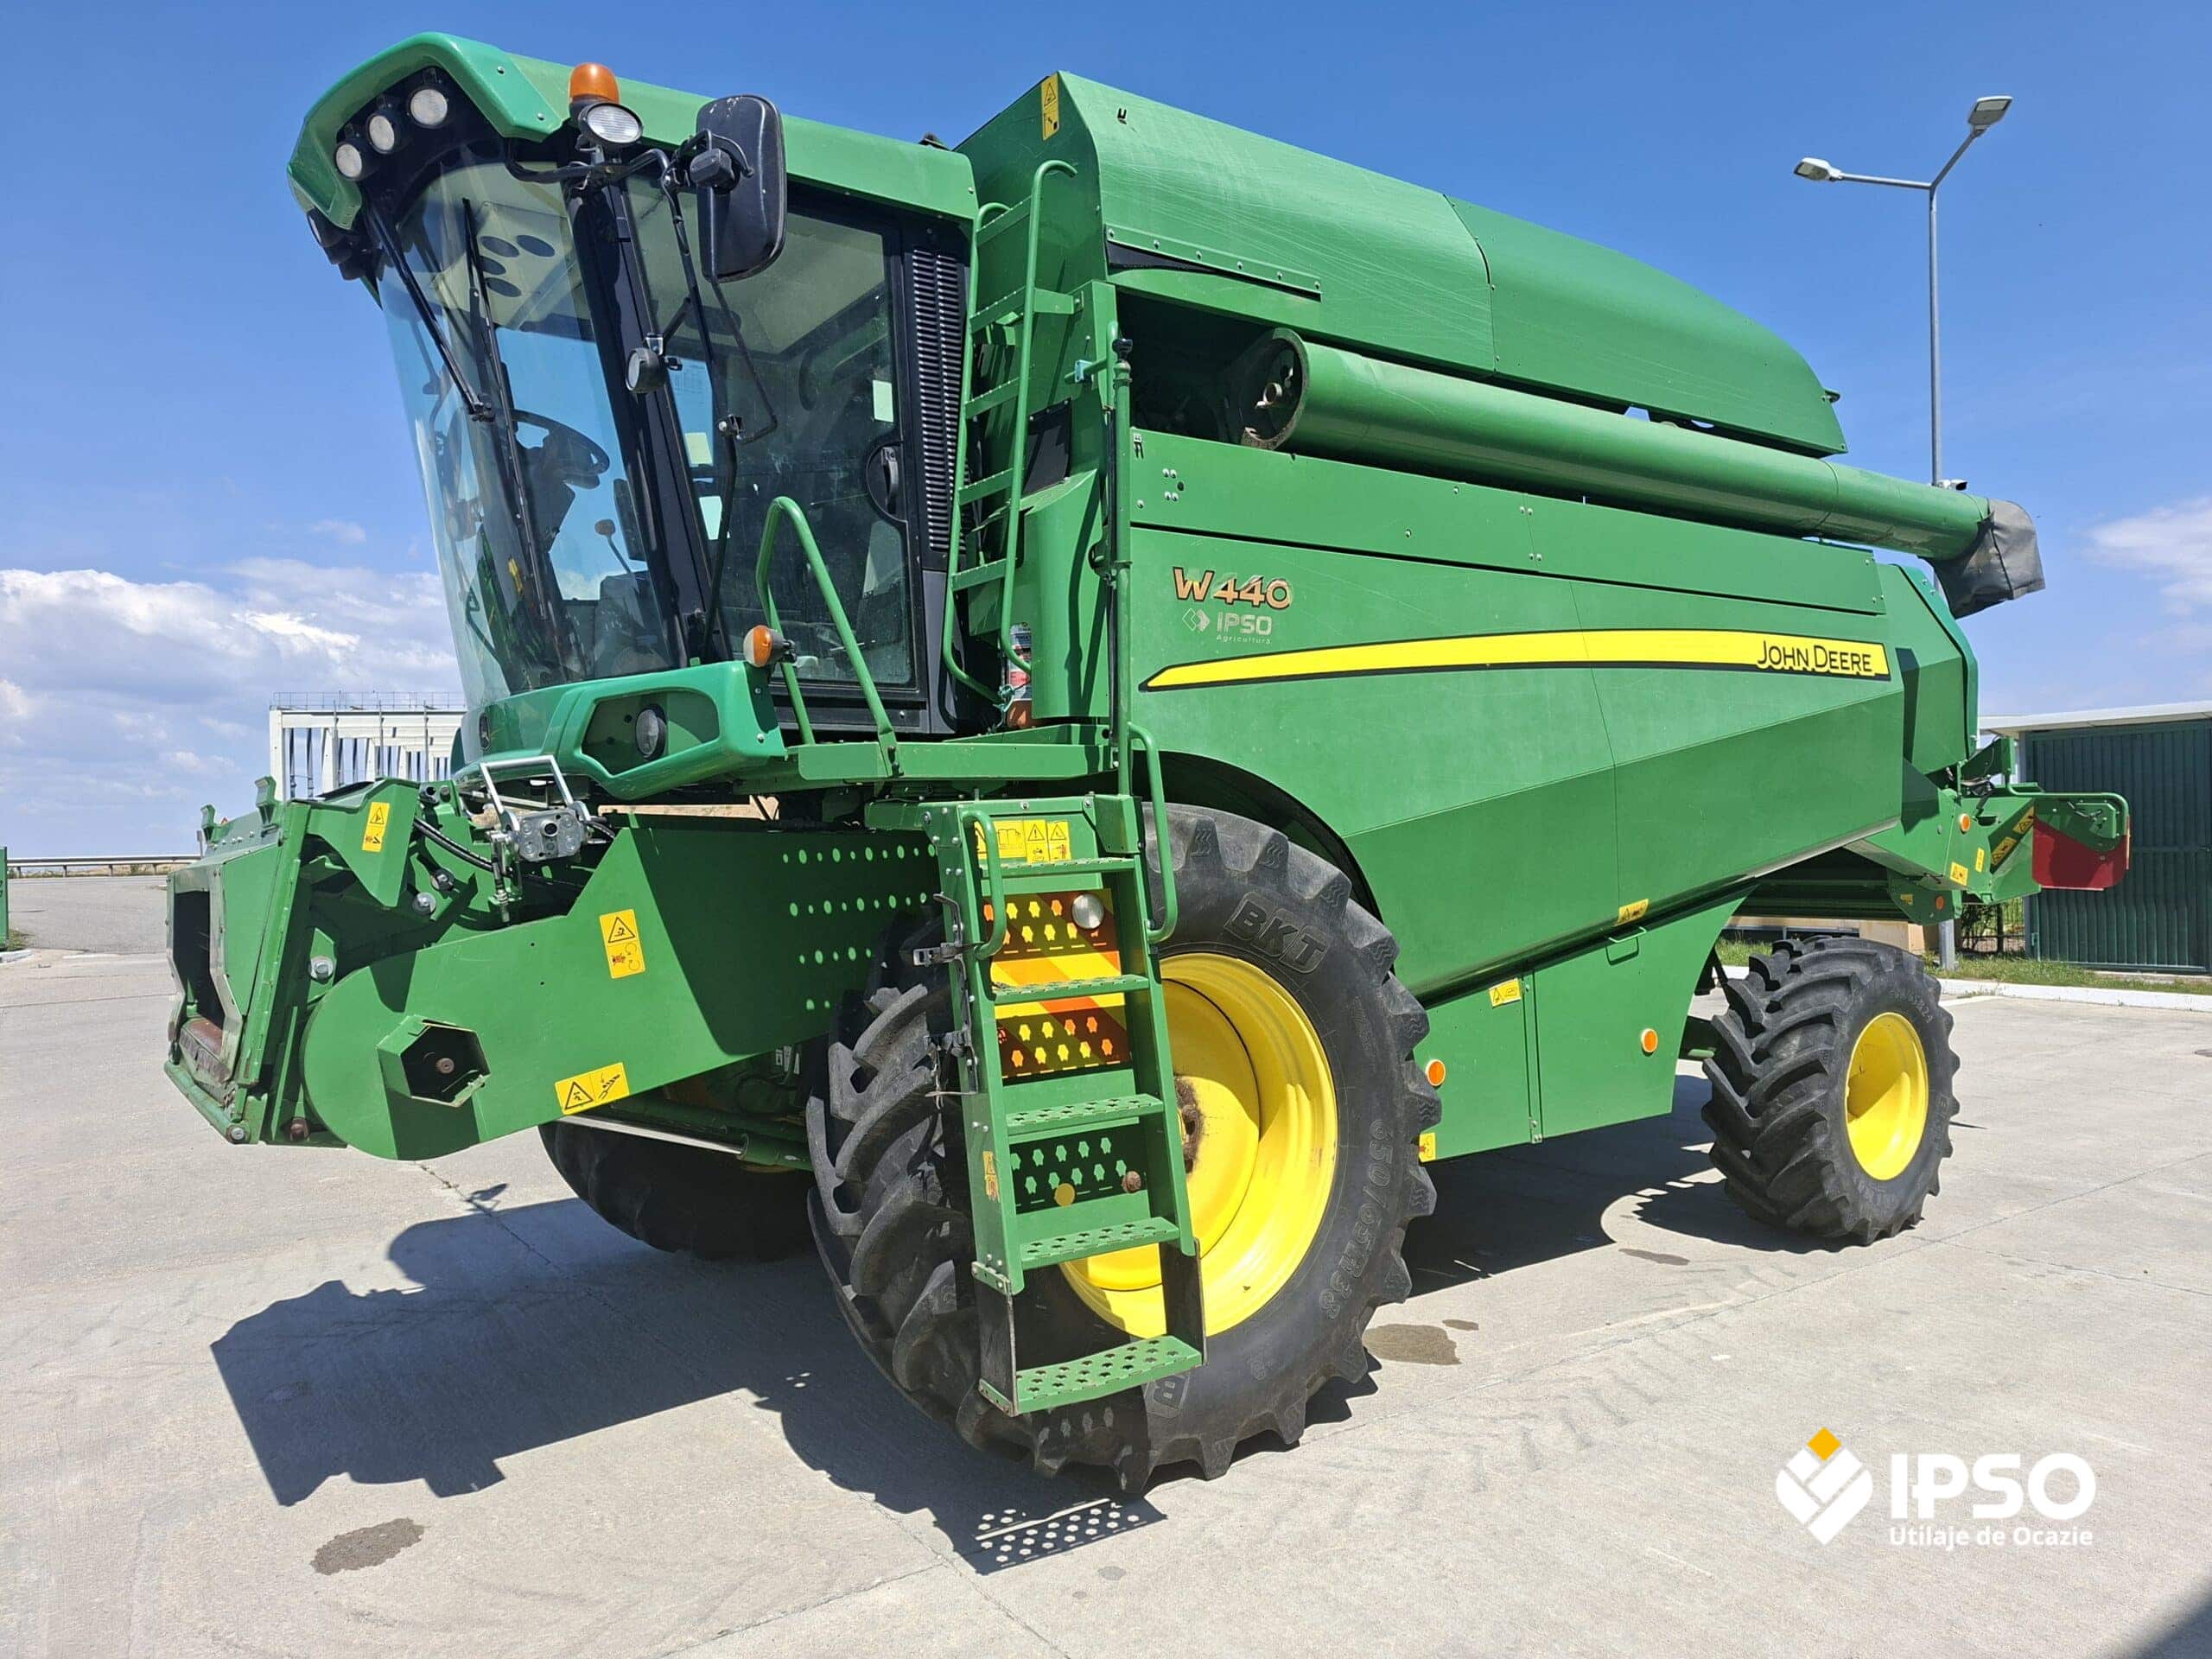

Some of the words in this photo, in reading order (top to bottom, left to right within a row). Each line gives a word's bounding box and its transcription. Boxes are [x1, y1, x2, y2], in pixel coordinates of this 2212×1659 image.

[1172, 566, 1292, 610] W440
[1216, 611, 1273, 636] IPSO
[1757, 640, 1809, 667] JOHN
[1814, 645, 1872, 672] DEERE
[1227, 895, 1328, 969] BKT
